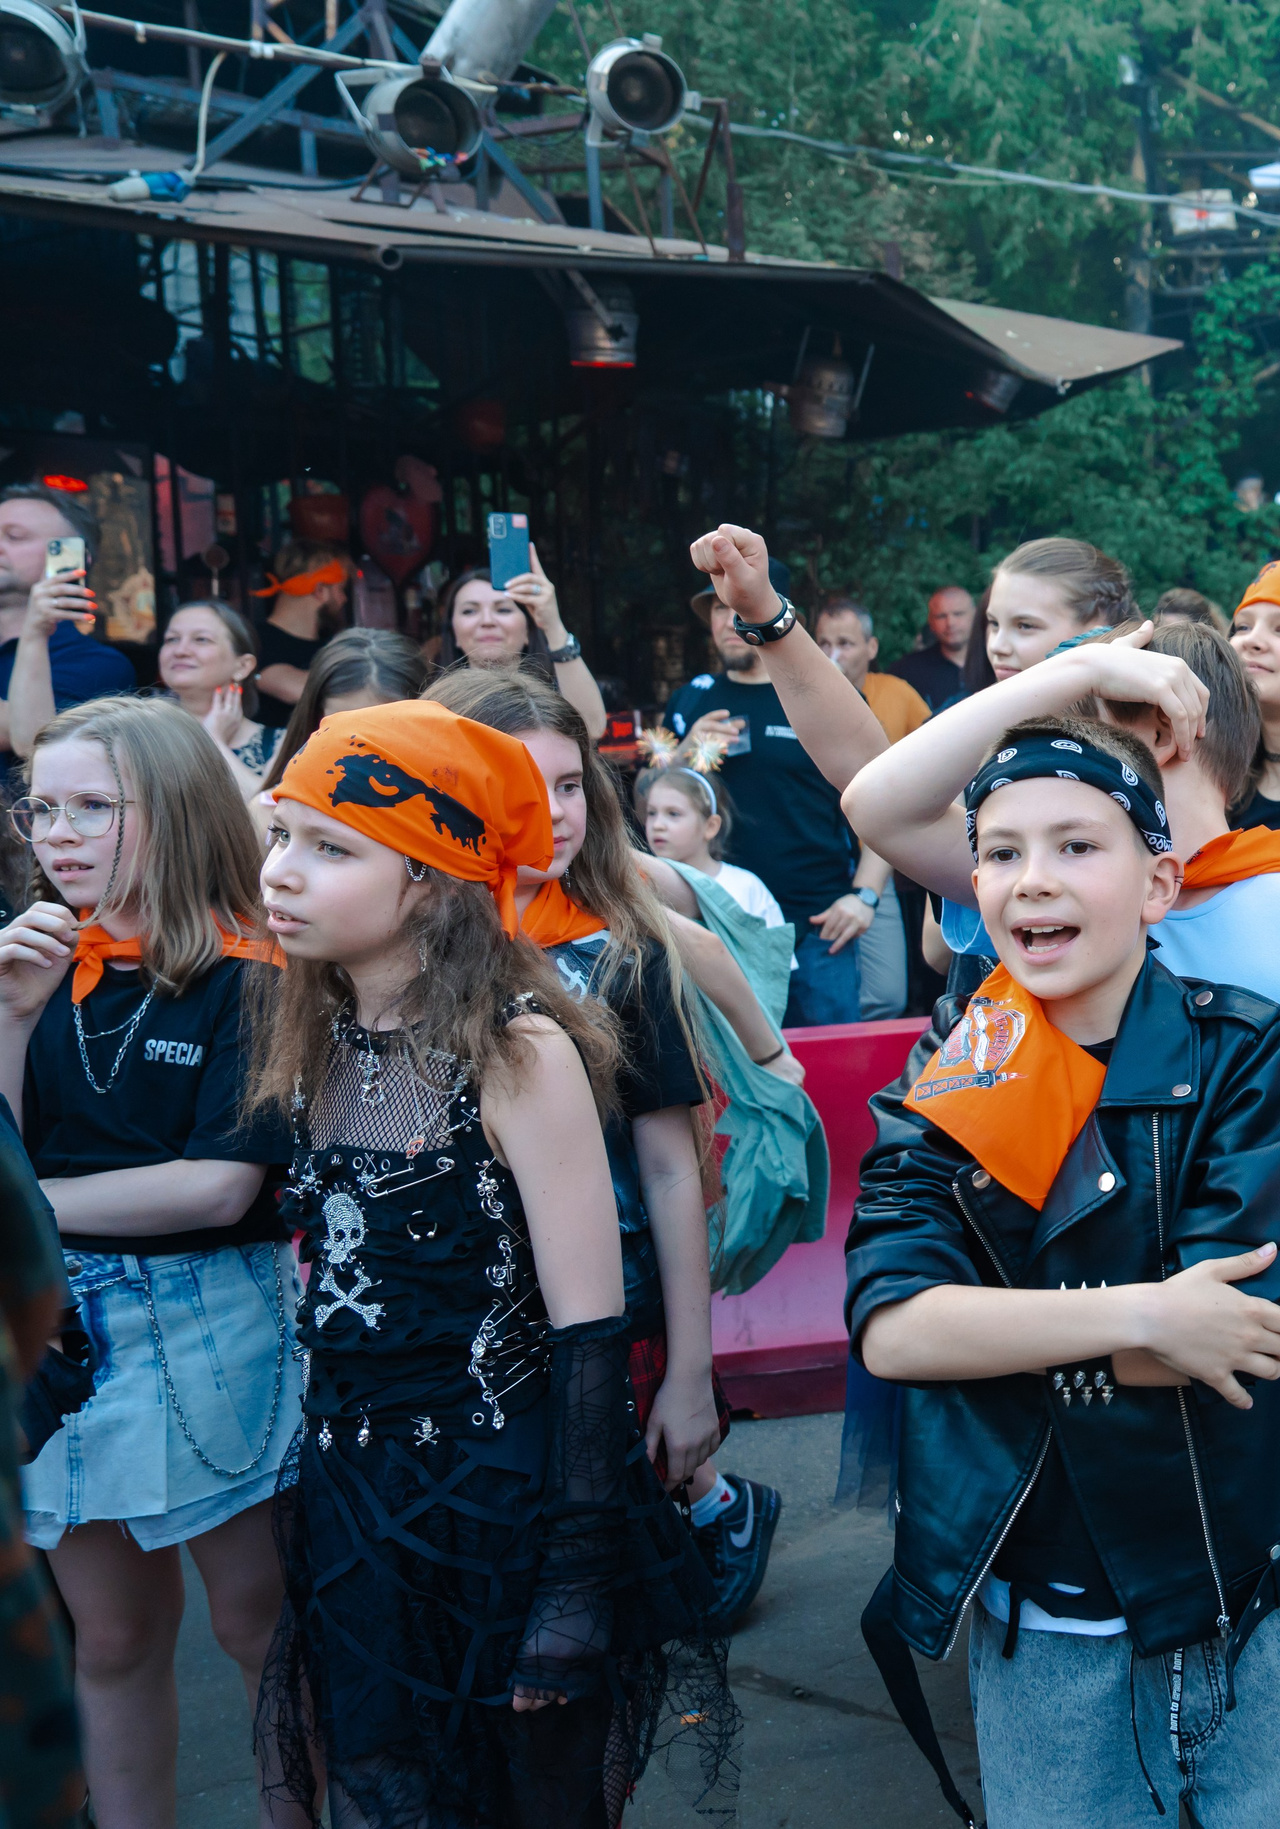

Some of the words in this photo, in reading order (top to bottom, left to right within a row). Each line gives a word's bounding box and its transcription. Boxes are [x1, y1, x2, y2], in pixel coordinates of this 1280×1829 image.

[144, 1038, 208, 1068] SPECIA
[1170, 1701, 1180, 1712] to
[1169, 1712, 1179, 1732] born
